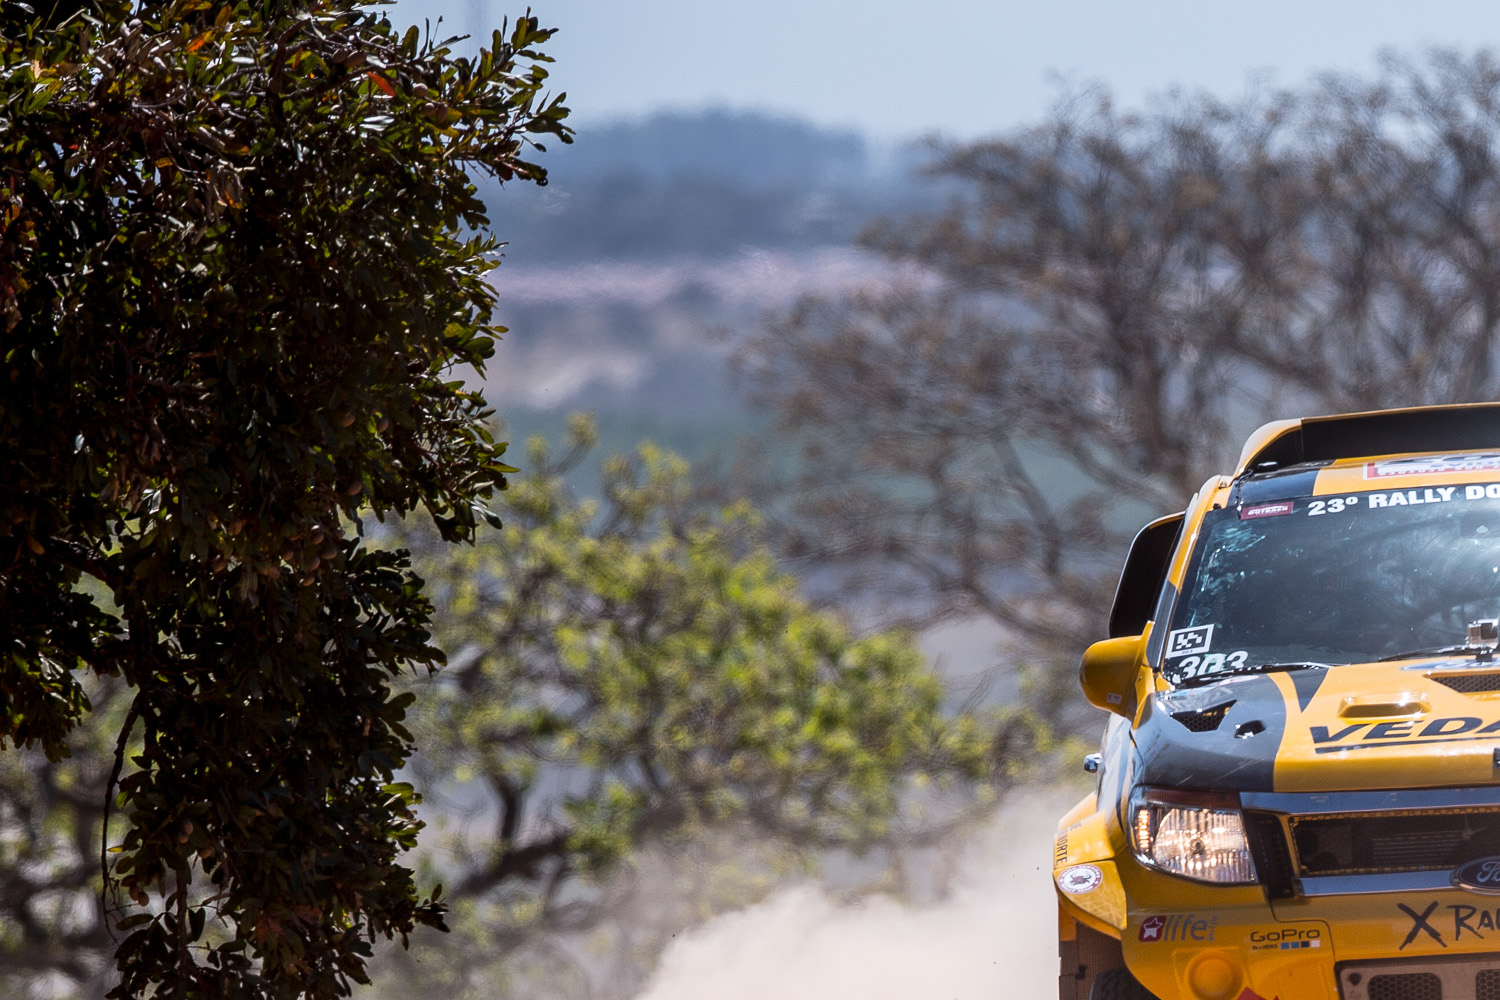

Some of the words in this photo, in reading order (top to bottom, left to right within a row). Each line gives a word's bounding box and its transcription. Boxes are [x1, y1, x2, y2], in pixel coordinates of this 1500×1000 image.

[1308, 496, 1358, 516] 23º
[1368, 486, 1456, 509] RALLY
[1250, 929, 1321, 943] GoPro
[1397, 900, 1448, 951] X
